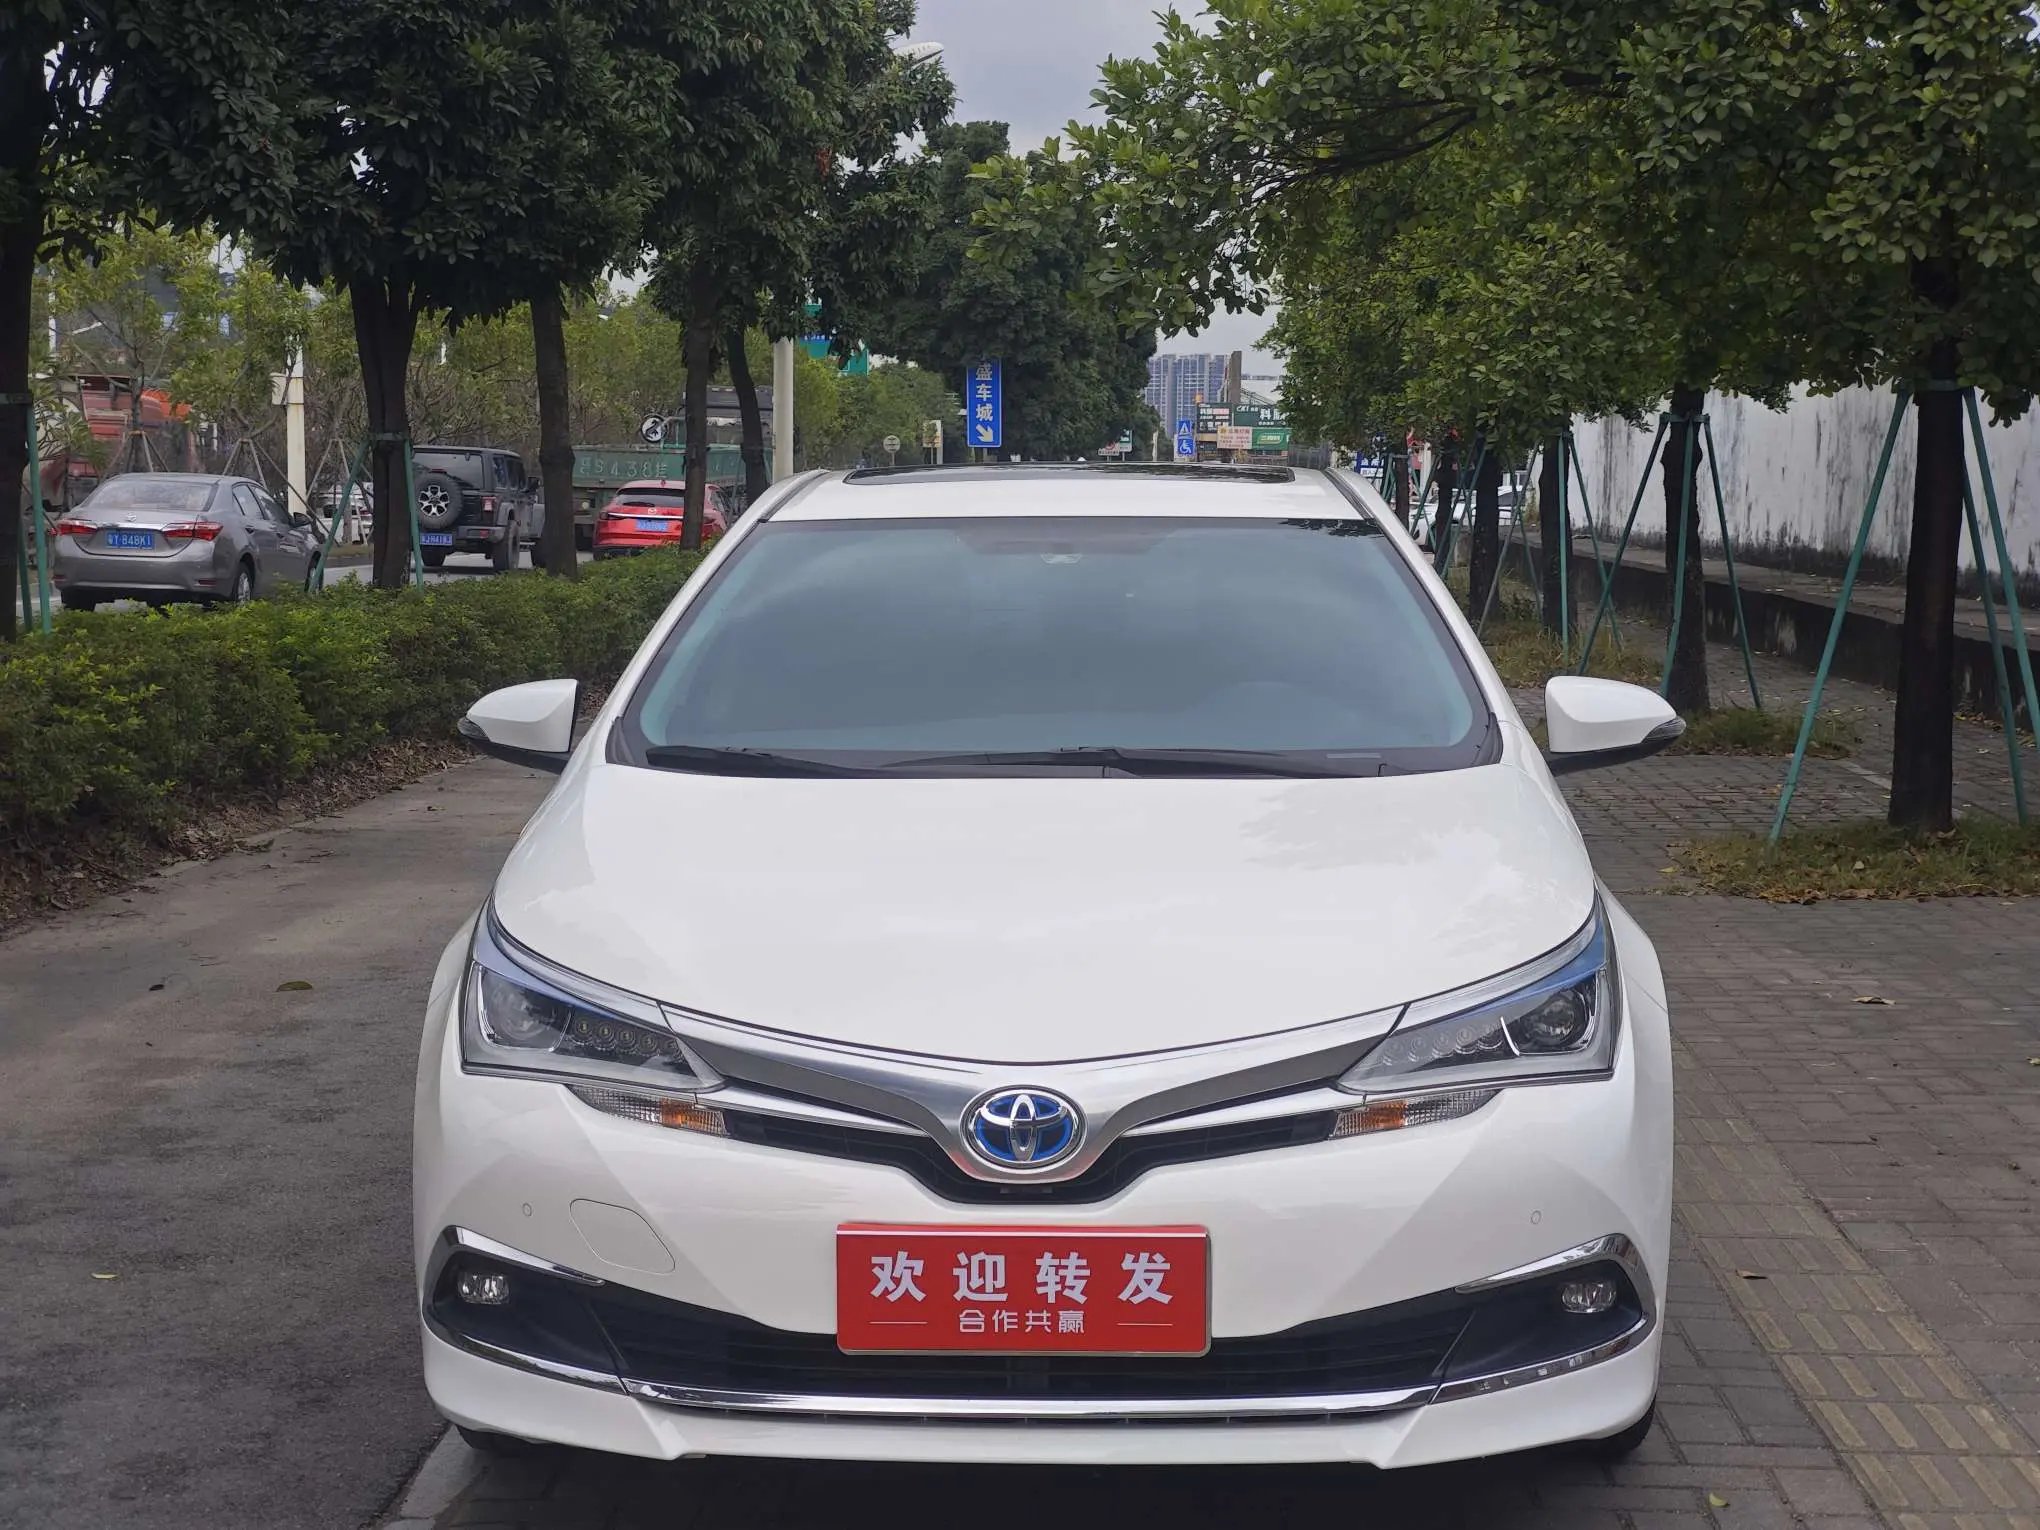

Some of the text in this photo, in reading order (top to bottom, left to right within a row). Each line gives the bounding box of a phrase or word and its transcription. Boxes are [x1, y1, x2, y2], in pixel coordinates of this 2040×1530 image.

[870, 1250, 1174, 1304] 欢迎转发
[958, 1309, 1085, 1334] 合作共赢
